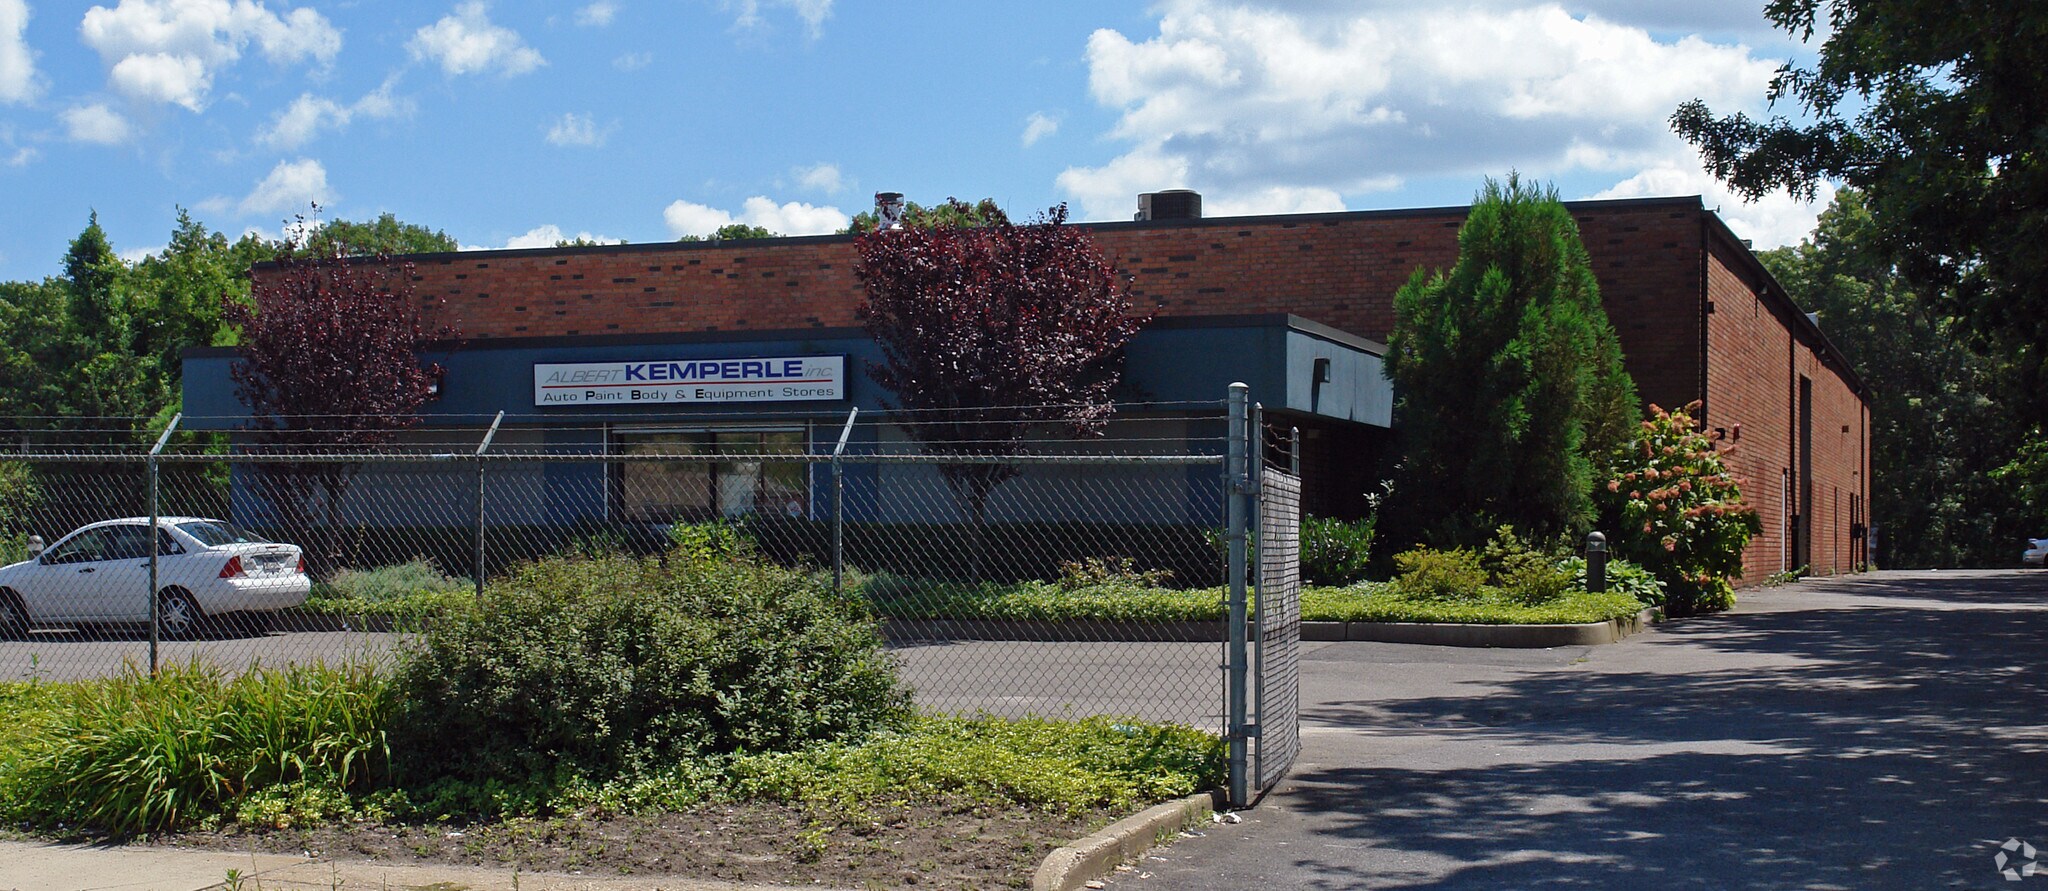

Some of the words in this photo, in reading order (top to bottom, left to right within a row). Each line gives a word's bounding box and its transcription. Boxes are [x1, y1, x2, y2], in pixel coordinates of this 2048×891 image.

[545, 369, 623, 383] ALBERT
[625, 360, 803, 381] KEMPERLE
[804, 363, 833, 377] inc.
[543, 391, 578, 402] Auto
[585, 389, 623, 401] Paint
[631, 389, 668, 402] Body
[675, 389, 686, 399] &
[695, 387, 774, 400] Equipment
[782, 386, 835, 397] Stores
